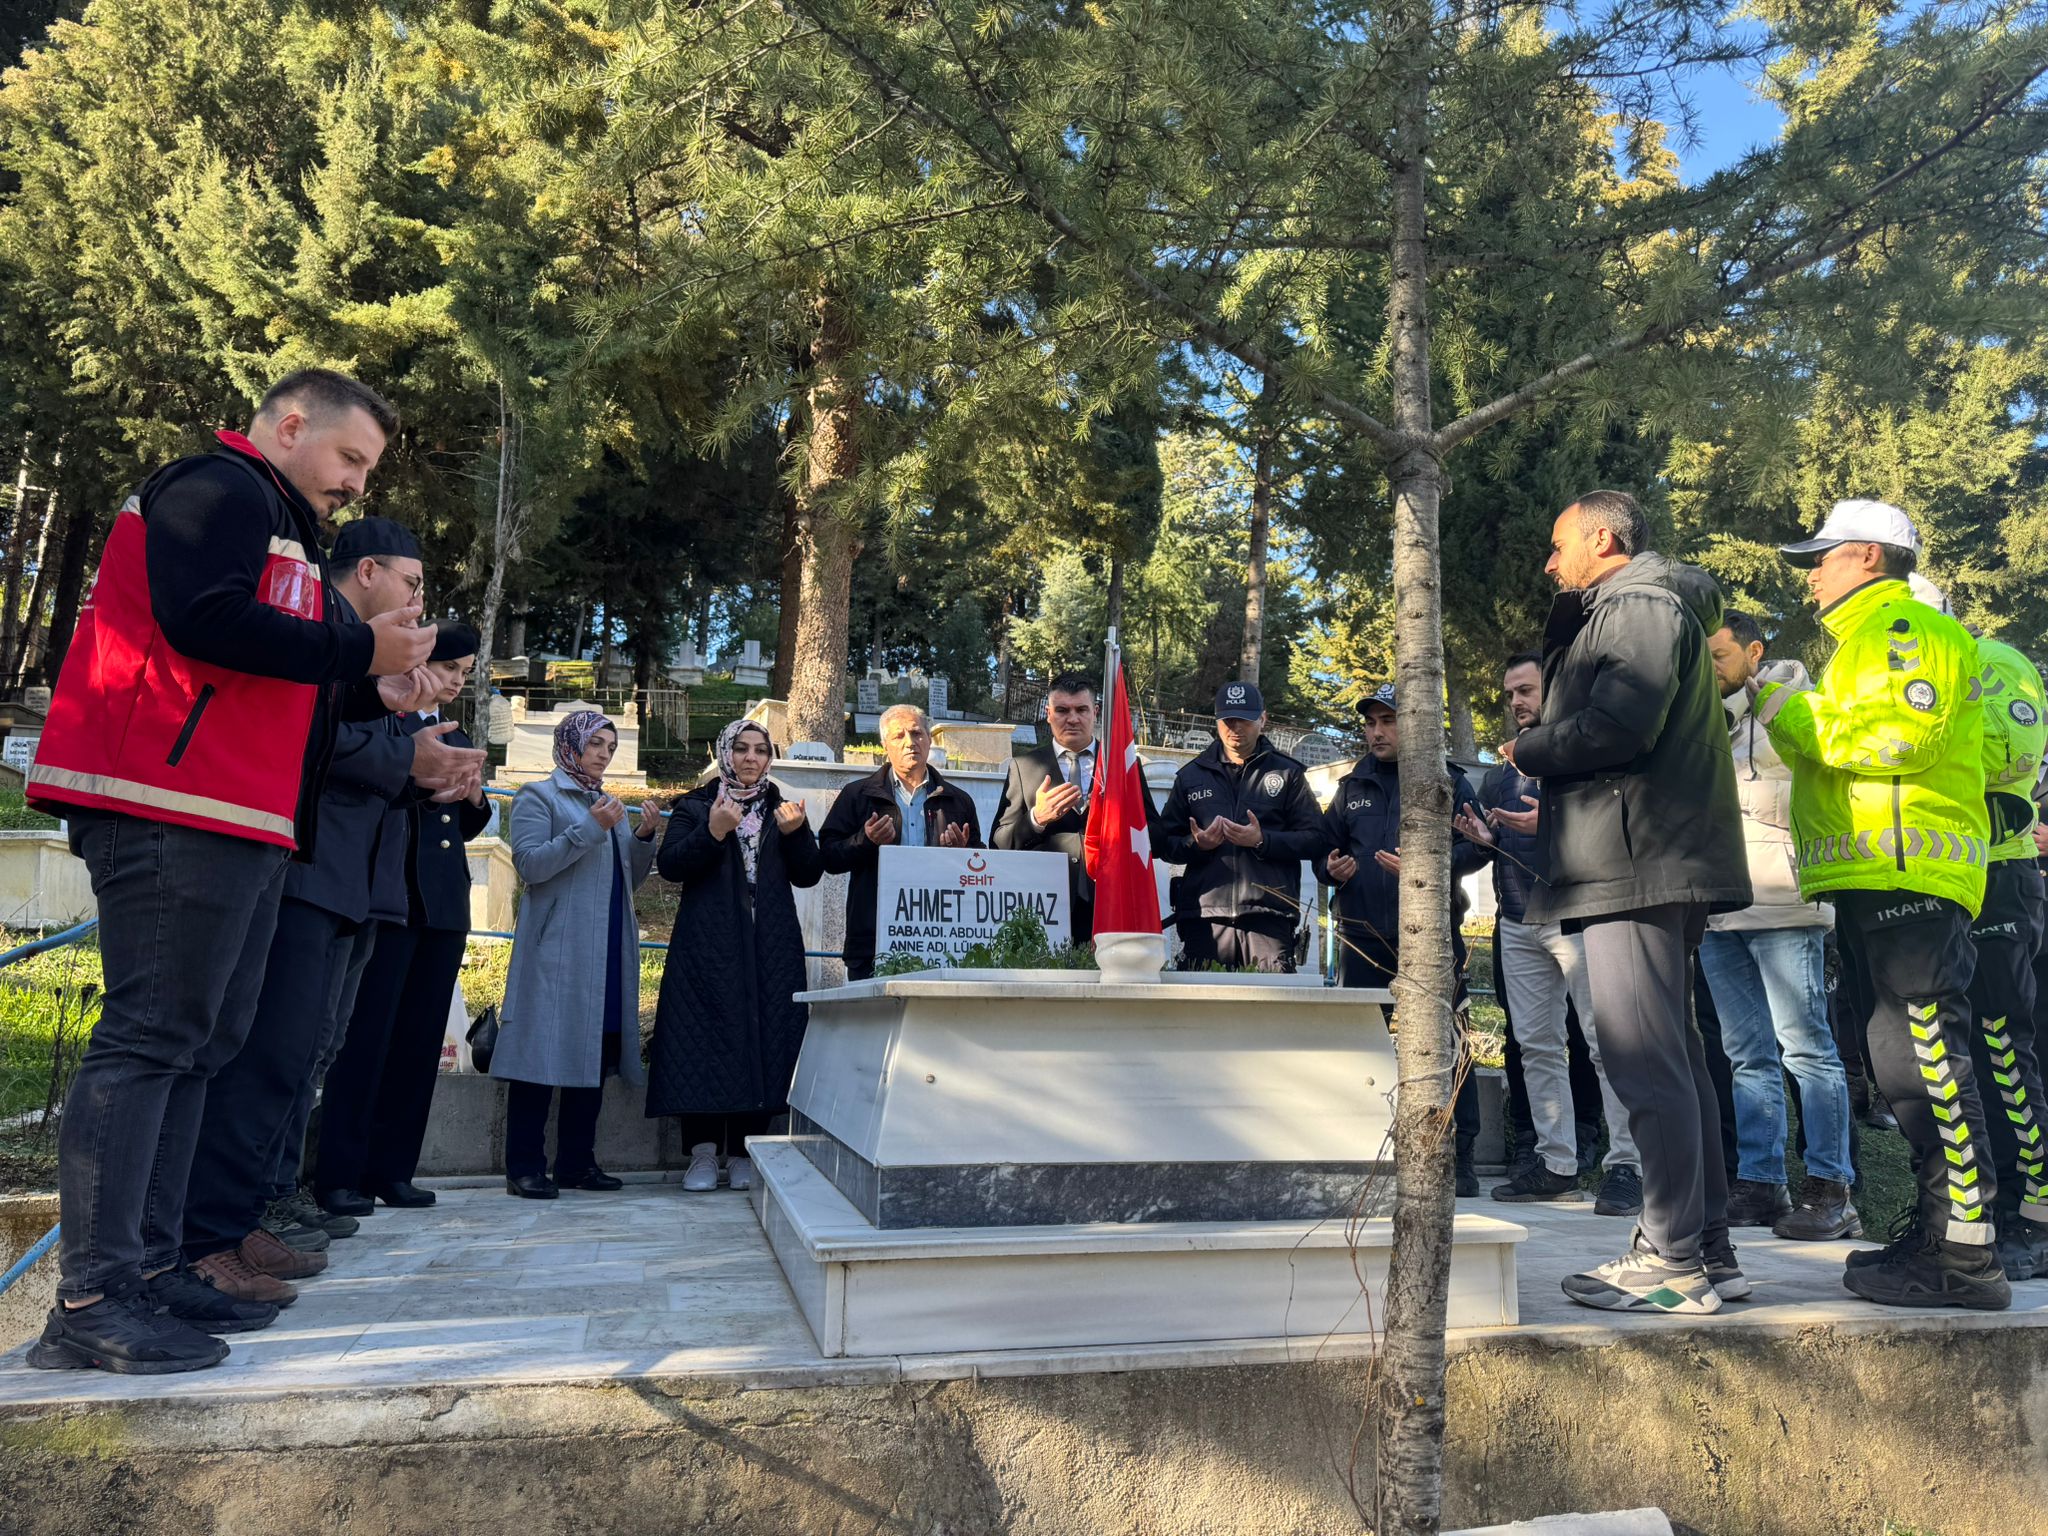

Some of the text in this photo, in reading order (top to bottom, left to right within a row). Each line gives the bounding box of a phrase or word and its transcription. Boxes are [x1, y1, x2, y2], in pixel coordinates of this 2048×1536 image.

[959, 874, 995, 887] ŞEHİT
[895, 888, 1059, 925] AHMET DURMAZ
[888, 925, 996, 939] BABA ADI. ABDULL
[889, 940, 924, 952] ANNE
[926, 941, 950, 953] ADI.
